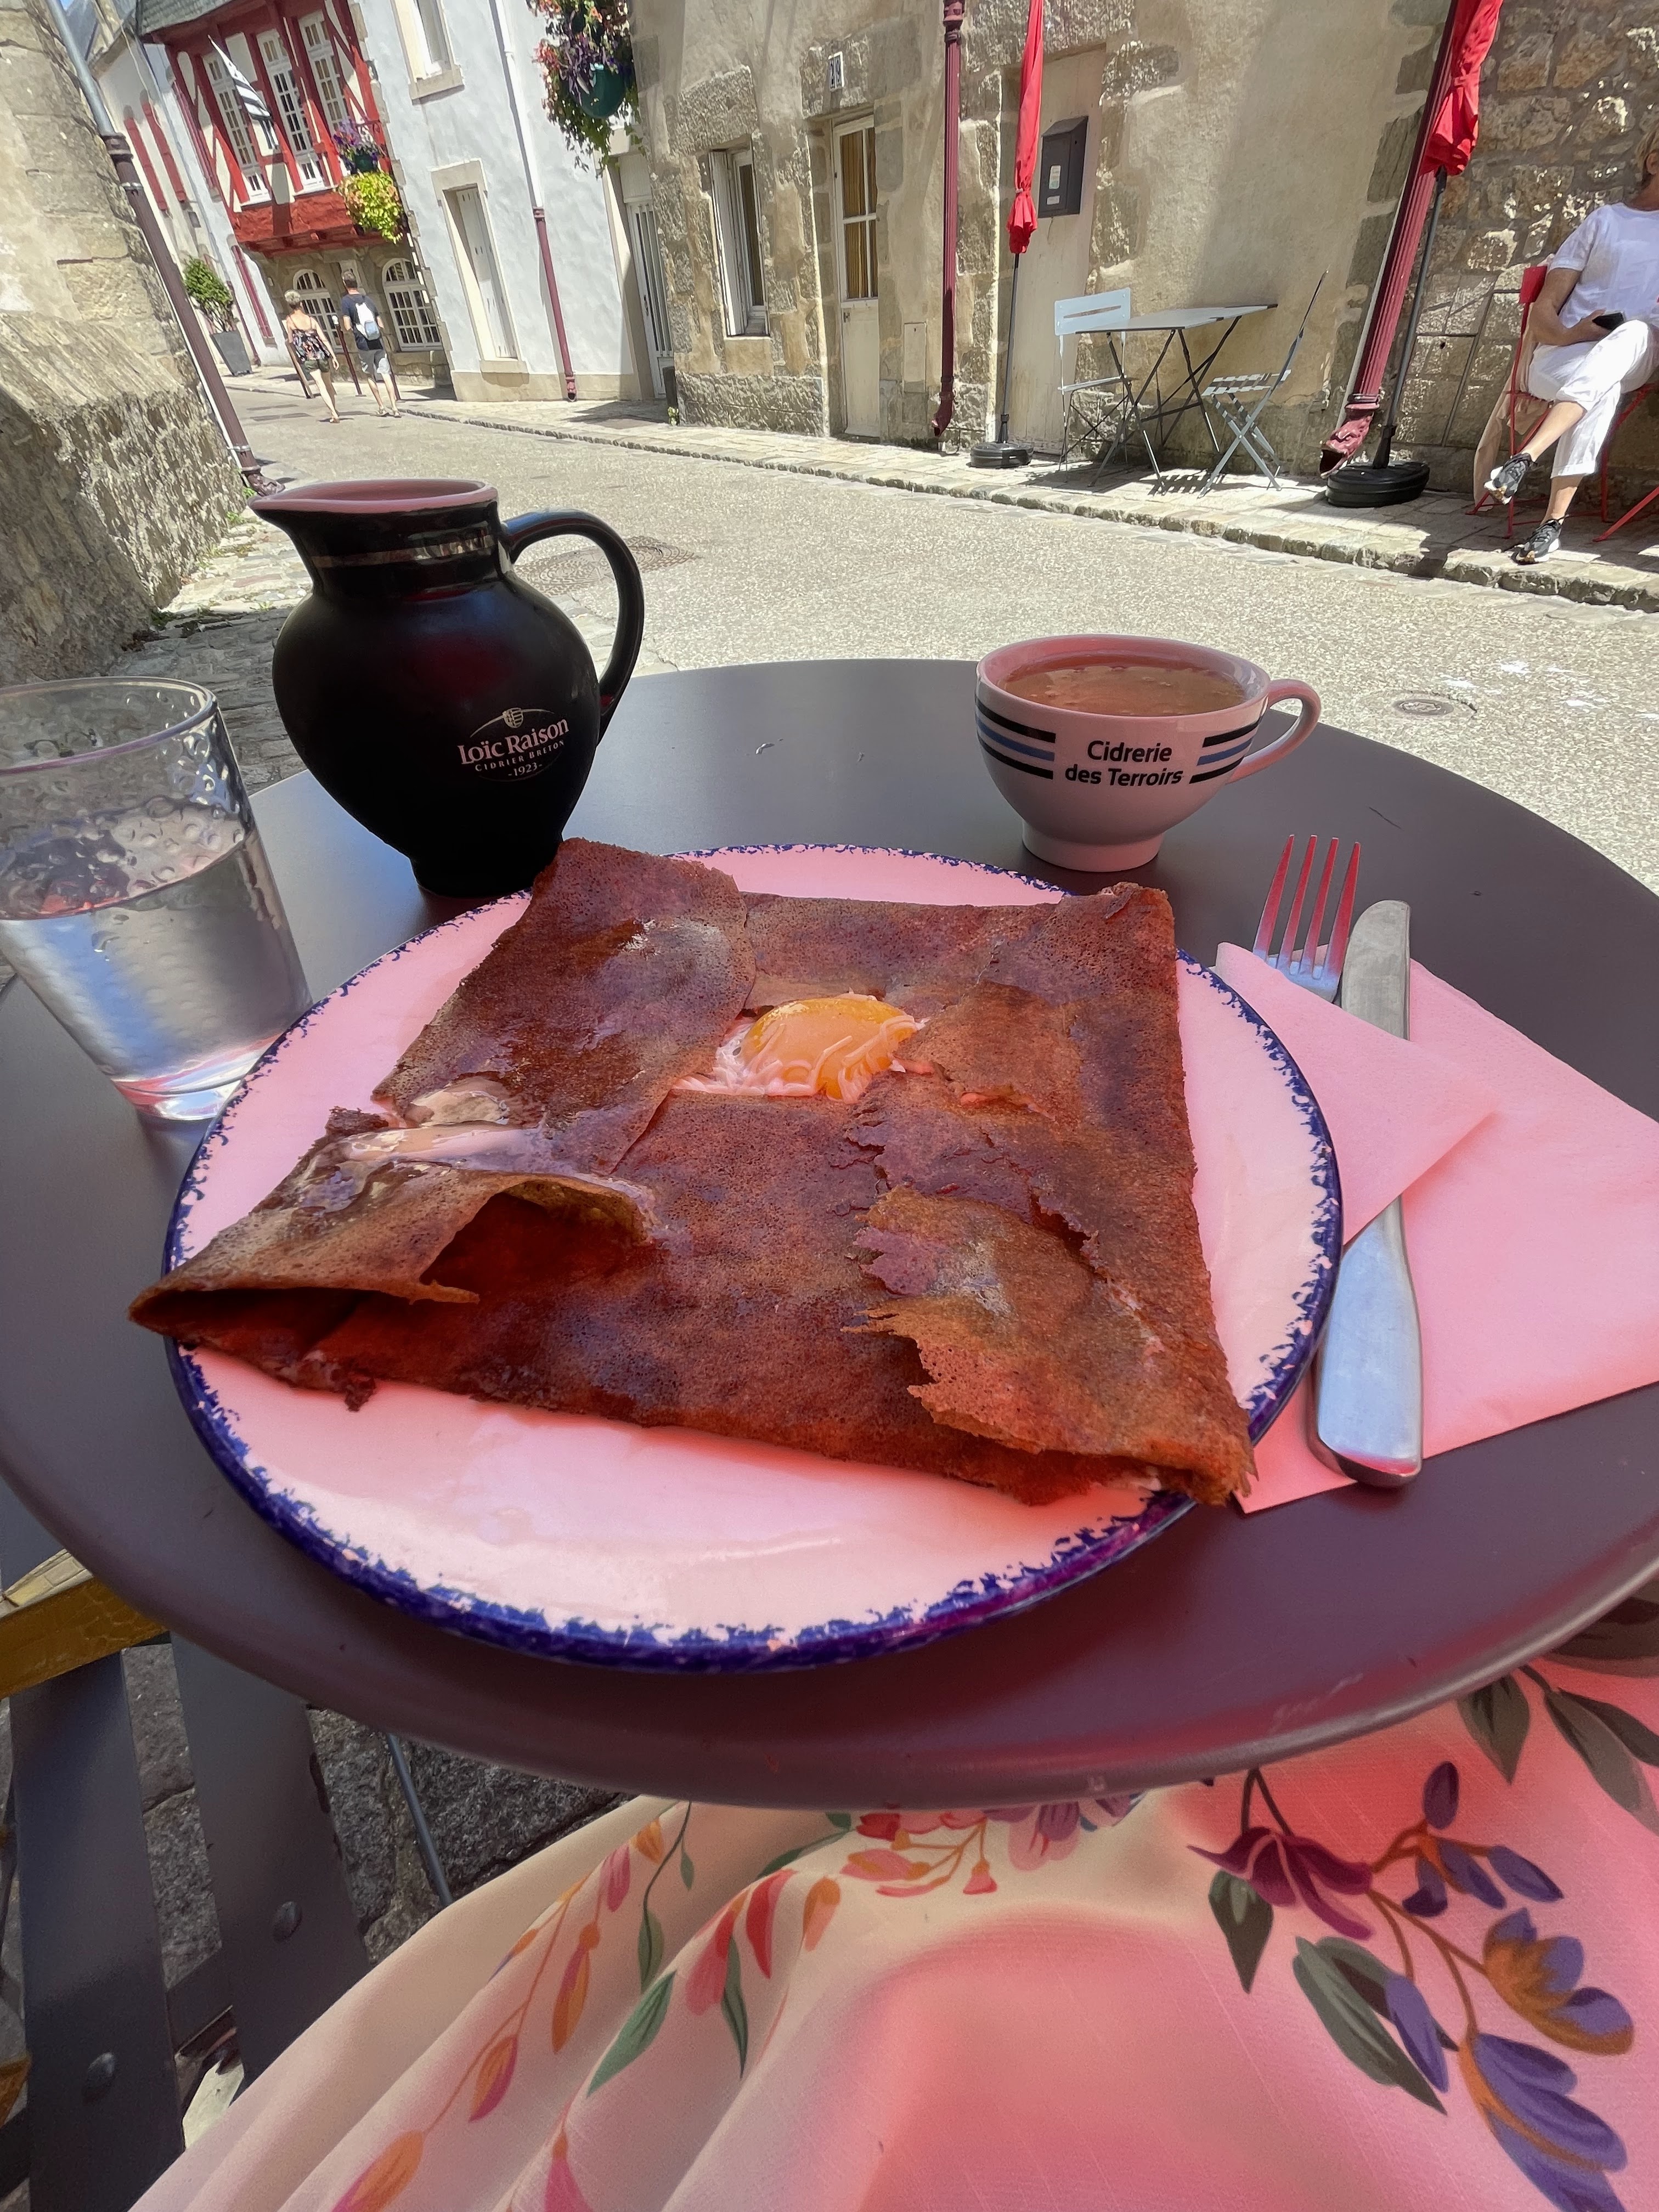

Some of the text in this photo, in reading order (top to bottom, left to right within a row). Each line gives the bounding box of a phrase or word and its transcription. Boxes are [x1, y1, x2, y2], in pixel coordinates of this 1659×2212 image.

[457, 719, 569, 764] Loïc Raison
[1087, 740, 1172, 763] Cidrerie
[475, 740, 565, 771] CIDRIER BRETON
[1065, 764, 1183, 787] des Terroirs
